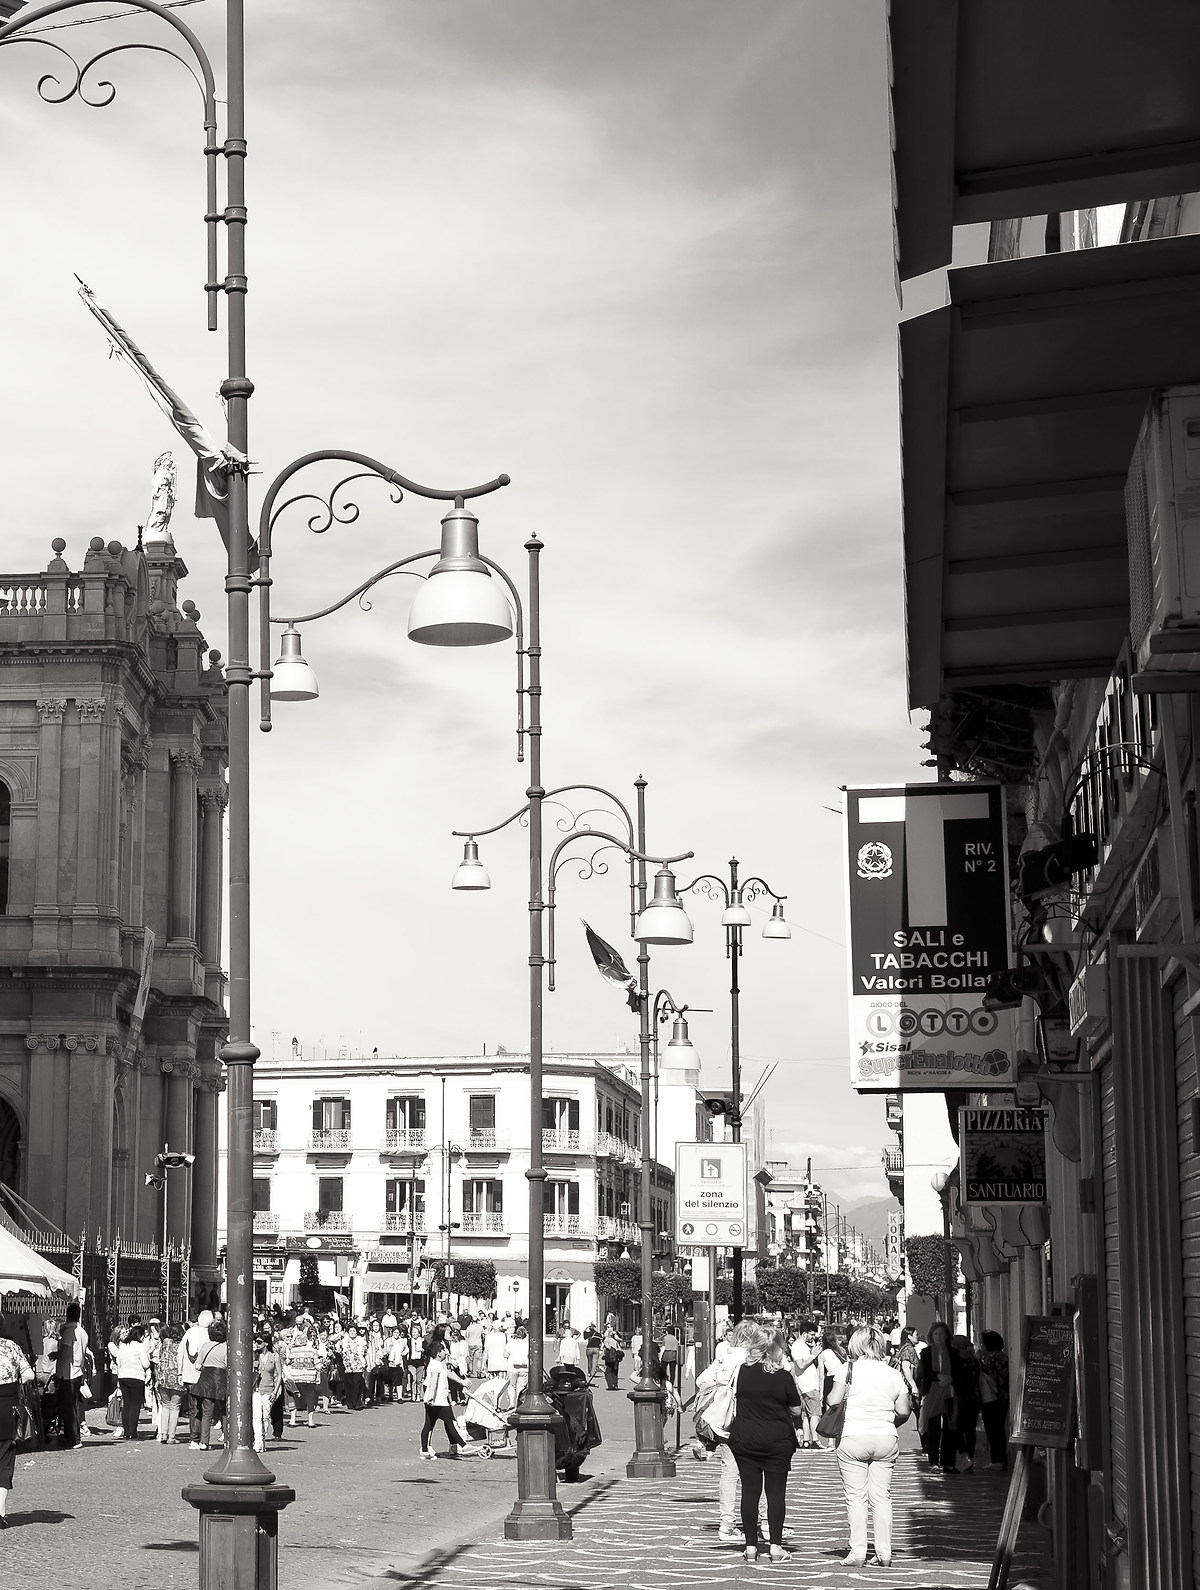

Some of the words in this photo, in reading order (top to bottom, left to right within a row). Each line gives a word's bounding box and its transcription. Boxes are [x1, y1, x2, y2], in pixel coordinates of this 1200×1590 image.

[965, 843, 995, 856] RIV.
[987, 859, 996, 873] 2
[893, 930, 945, 948] SALI
[952, 934, 964, 946] e
[870, 951, 988, 971] TABACCHI
[860, 974, 923, 990] Valori
[931, 974, 991, 989] Bollat
[866, 1007, 998, 1038] LOTTO
[876, 1041, 912, 1053] Sisal
[858, 1050, 990, 1077] SuperEnalotto
[966, 1110, 1042, 1131] PIZZERIA
[969, 1183, 1044, 1198] SANTUARIO
[685, 1200, 699, 1208] del
[702, 1200, 739, 1209] silenzio
[370, 1282, 412, 1291] TABACC
